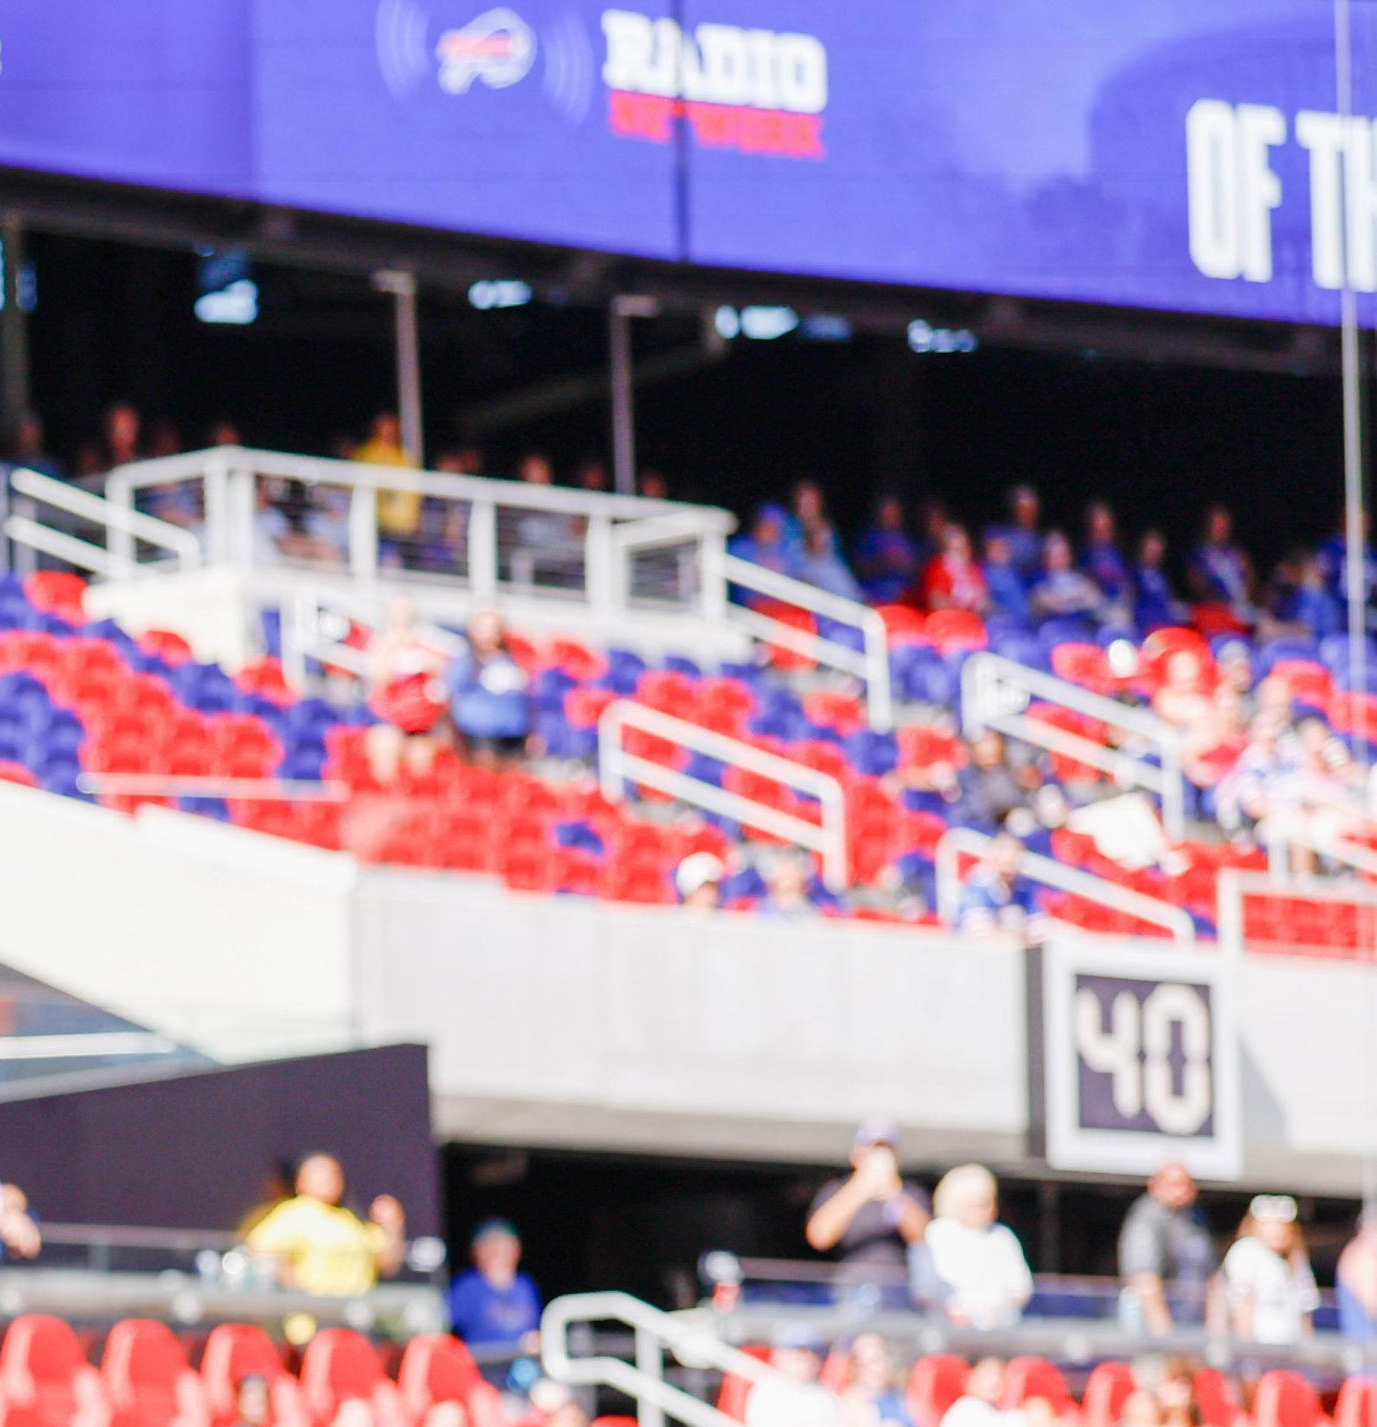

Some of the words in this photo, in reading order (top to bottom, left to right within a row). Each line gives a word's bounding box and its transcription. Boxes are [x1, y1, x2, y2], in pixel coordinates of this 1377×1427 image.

[601, 8, 828, 115] RADIO
[1186, 97, 1287, 283] OF
[1075, 982, 1212, 1135] 40
